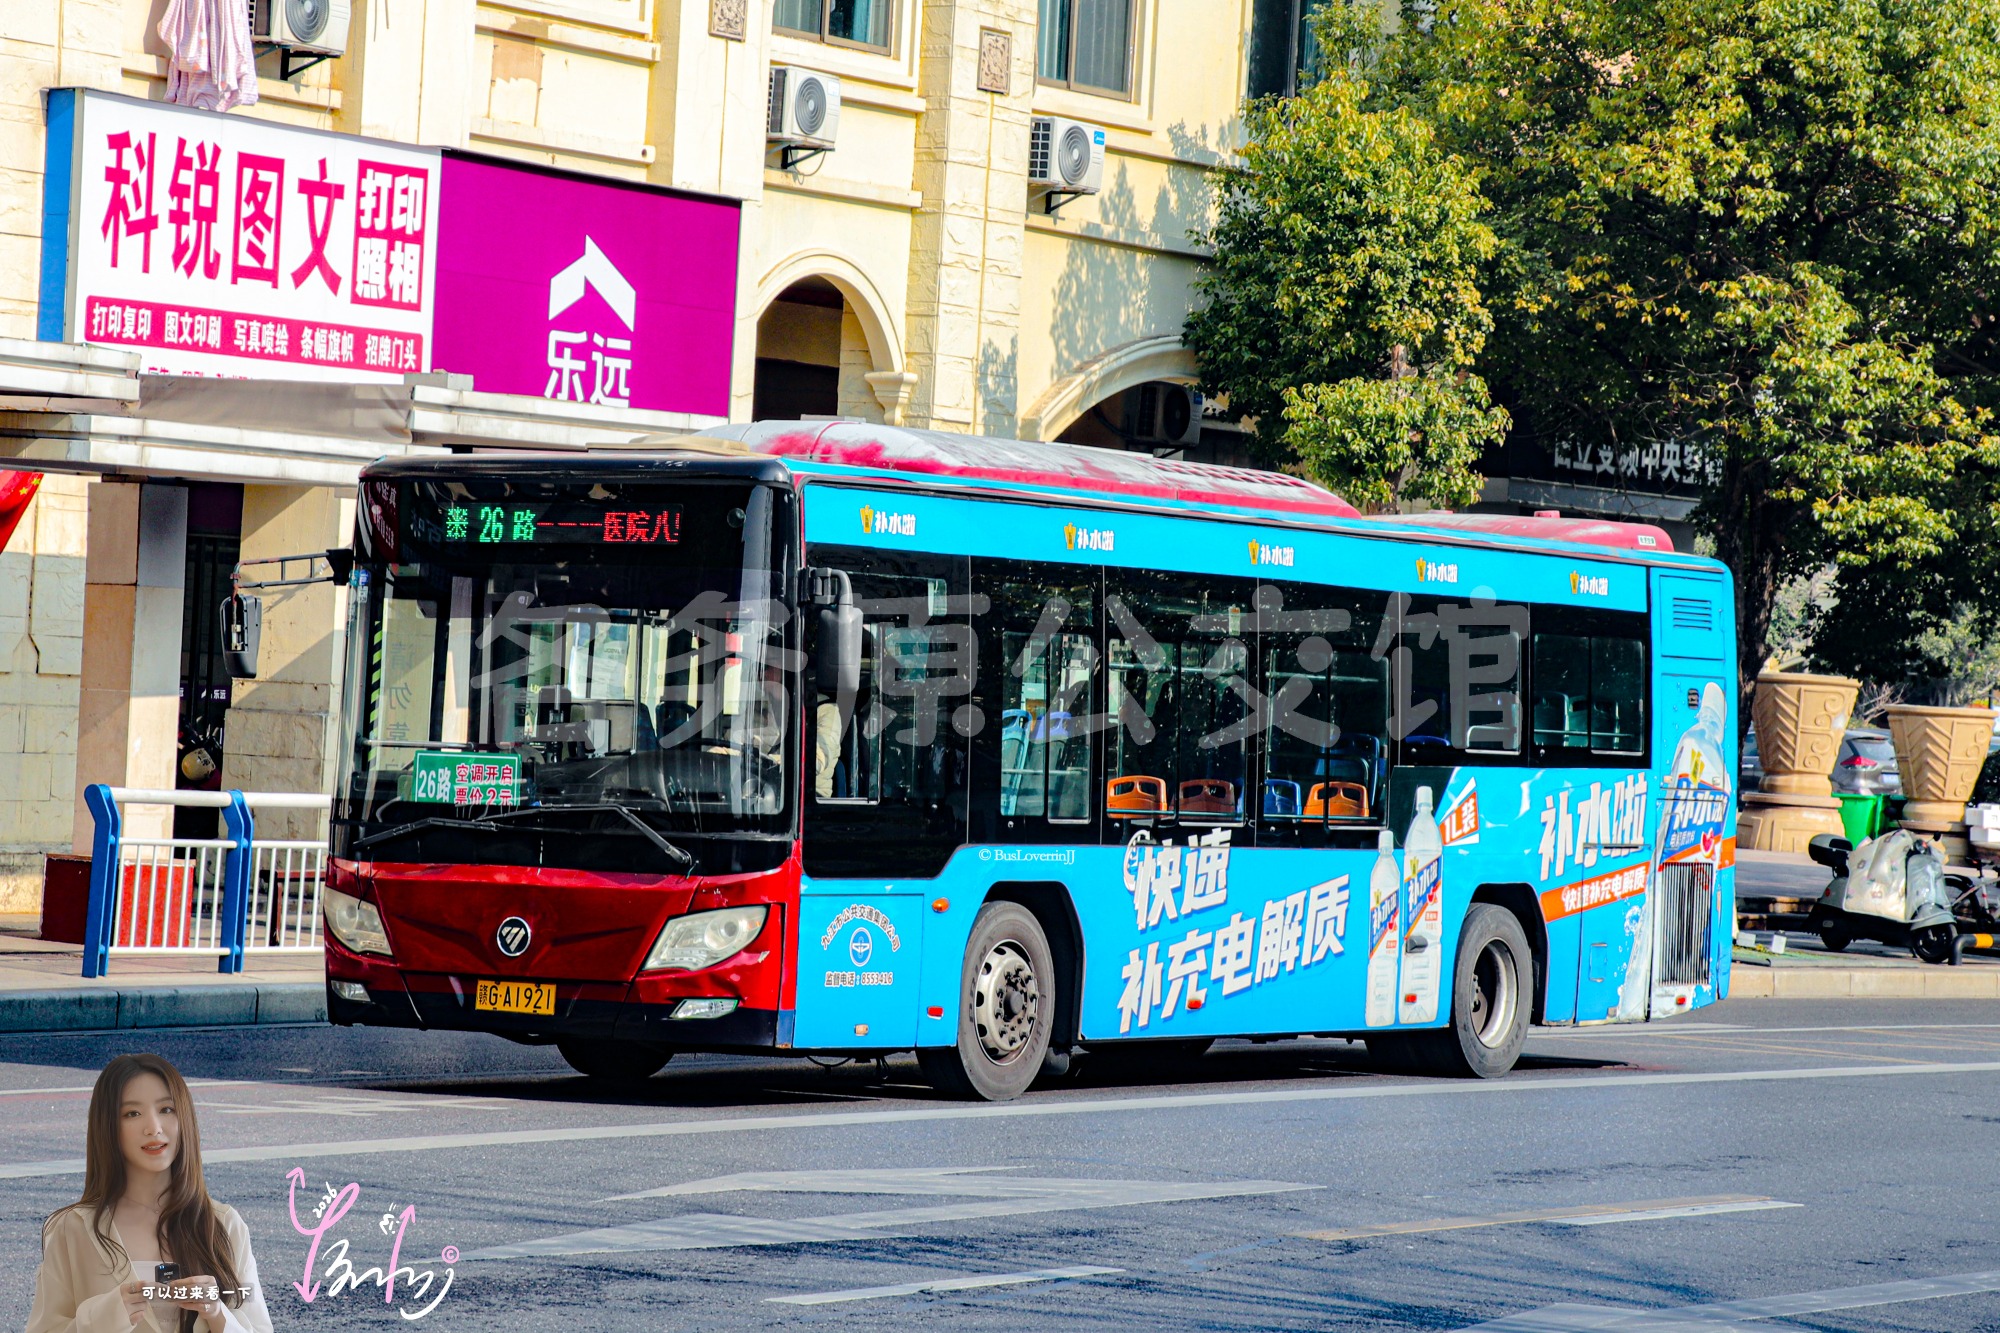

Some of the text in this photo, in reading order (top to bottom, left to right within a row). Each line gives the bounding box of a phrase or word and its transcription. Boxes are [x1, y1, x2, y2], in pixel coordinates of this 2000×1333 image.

[101, 130, 345, 297] 科锐图文
[360, 168, 424, 236] 打印
[355, 237, 421, 304] 照相
[92, 302, 417, 369] 打印复印 图文印刷 写真喷绘 条幅旗帜 招牌门头
[543, 329, 632, 408] 乐远
[874, 510, 917, 536] 补水啦
[1076, 527, 1115, 551] 补水啦
[1259, 544, 1295, 567] 补水啦
[1426, 562, 1459, 583] 补水啦
[1578, 575, 1609, 596] 补水啦
[417, 767, 452, 803] 26路
[455, 763, 514, 785] 空调开启
[1538, 771, 1648, 882] 补水啦
[1134, 827, 1232, 931] 快速
[1564, 865, 1646, 912] 快速补充电解质
[821, 903, 901, 952] 九江市公共交通集团公司
[1117, 873, 1350, 1034] 补充电解质
